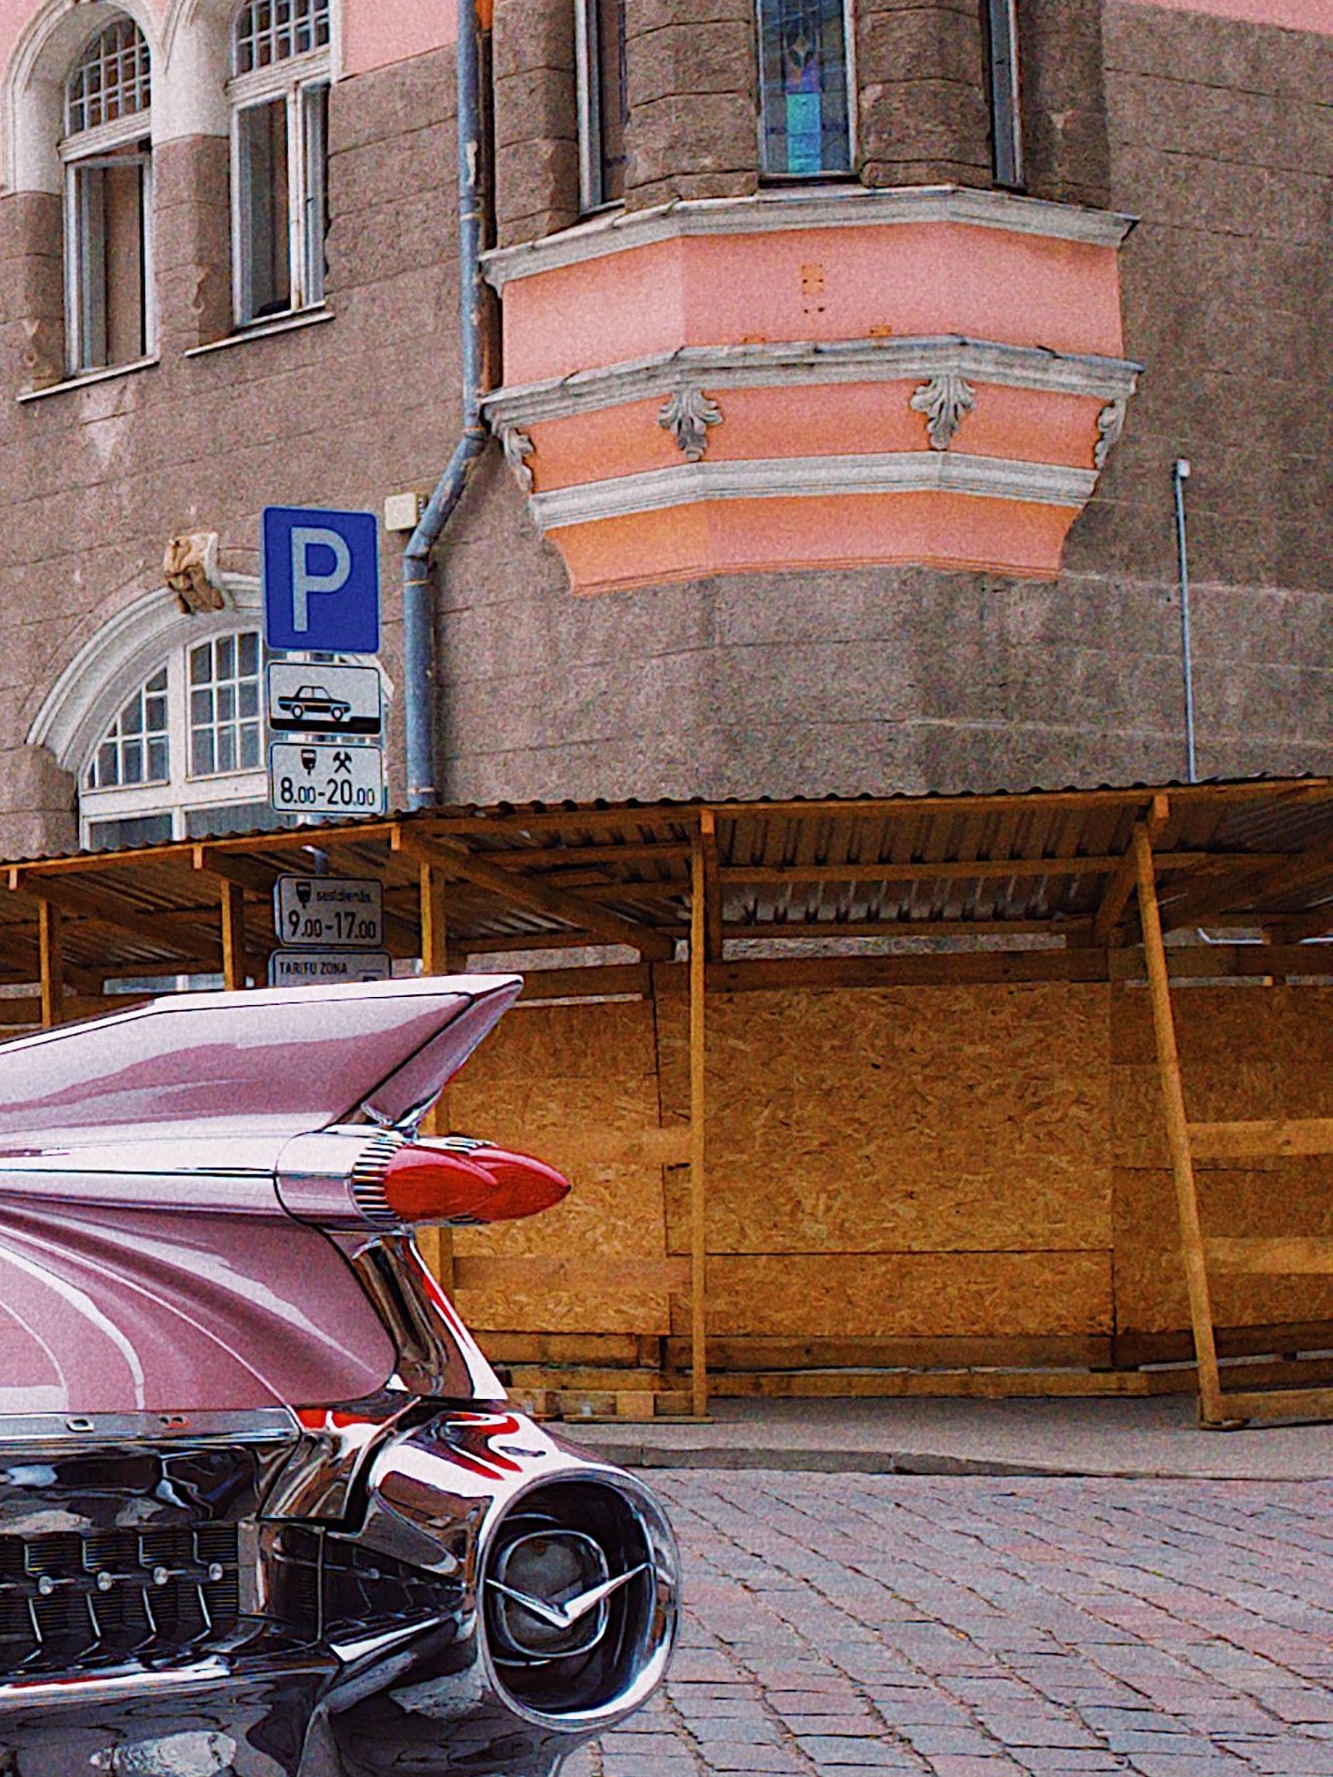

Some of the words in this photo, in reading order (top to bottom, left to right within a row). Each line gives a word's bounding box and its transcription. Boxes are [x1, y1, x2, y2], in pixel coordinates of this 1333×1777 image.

[291, 526, 351, 632] P
[280, 776, 375, 806] 8.00-20.00
[288, 909, 376, 939] 9.00-17.00
[320, 962, 348, 975] ZONA
